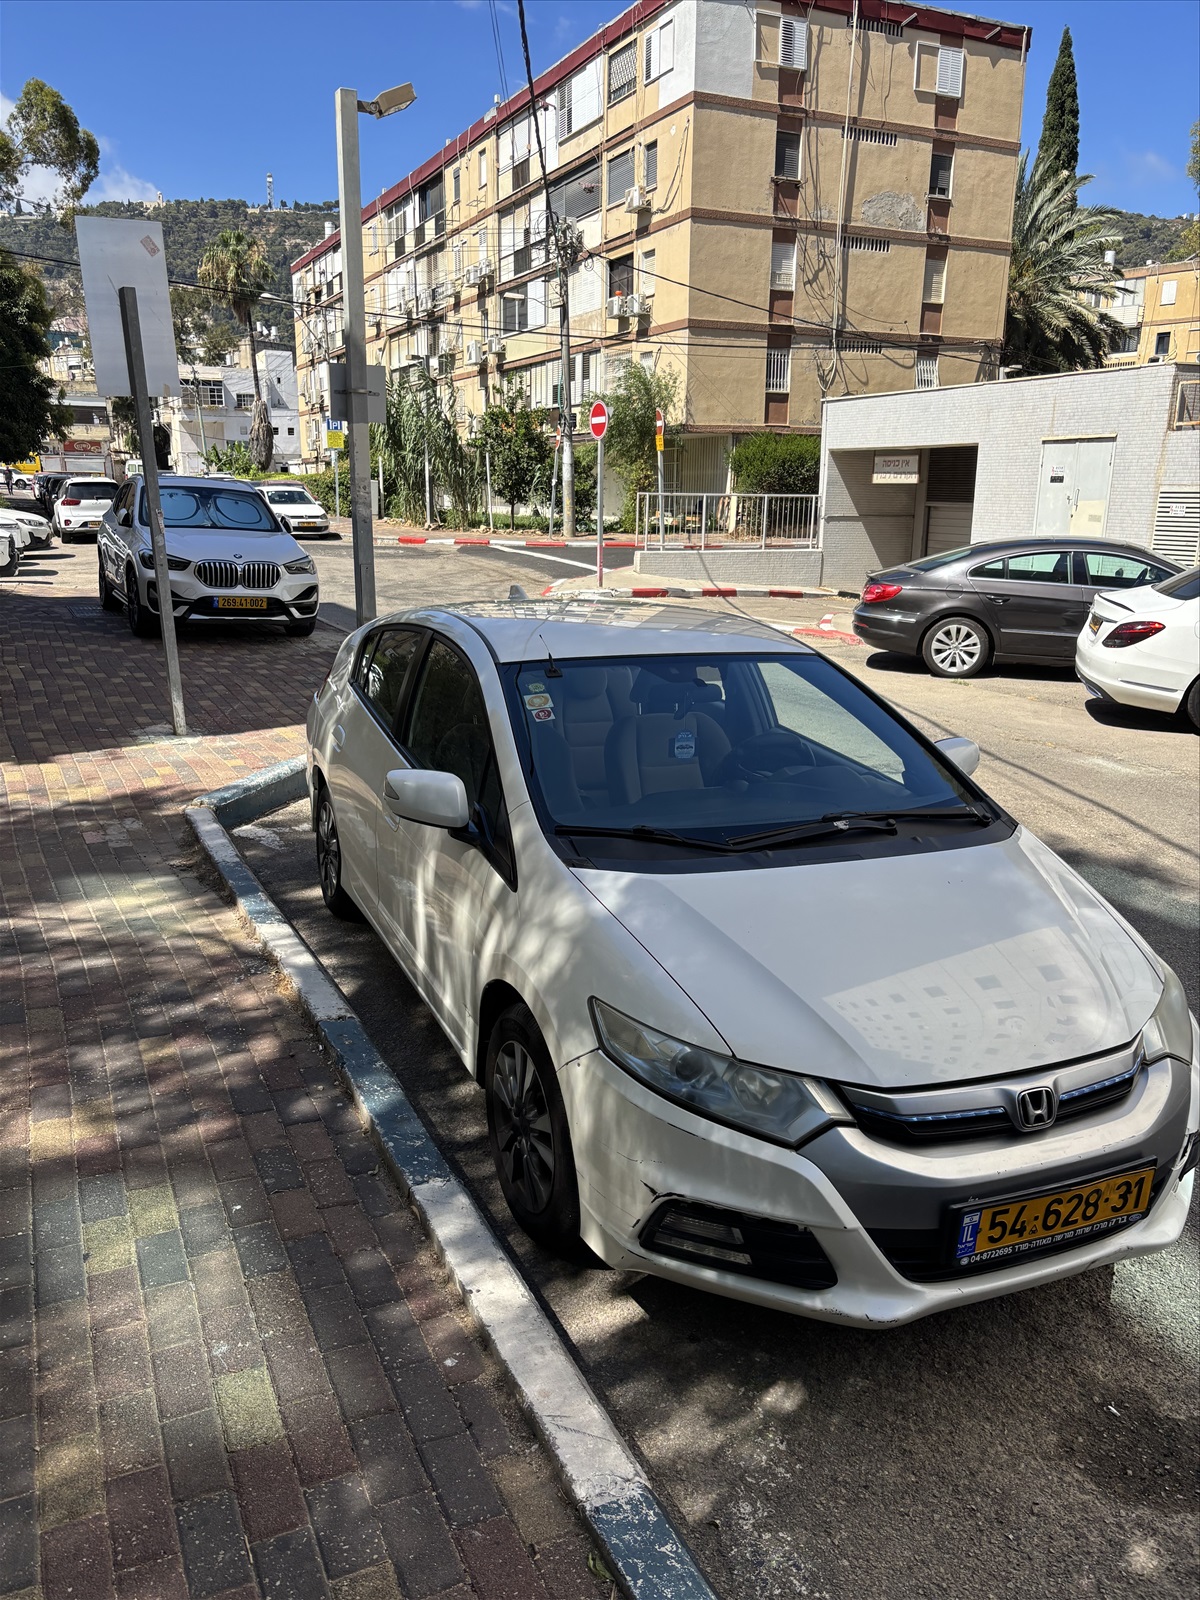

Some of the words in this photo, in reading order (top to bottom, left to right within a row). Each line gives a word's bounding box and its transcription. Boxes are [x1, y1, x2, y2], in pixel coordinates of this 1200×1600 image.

[882, 460, 900, 468] כניסה
[901, 459, 910, 468] אין
[1093, 1221, 1108, 1231] מרכז
[1109, 1215, 1127, 1227] ברק
[963, 1225, 974, 1242] IL
[1053, 1230, 1074, 1242] מורשה
